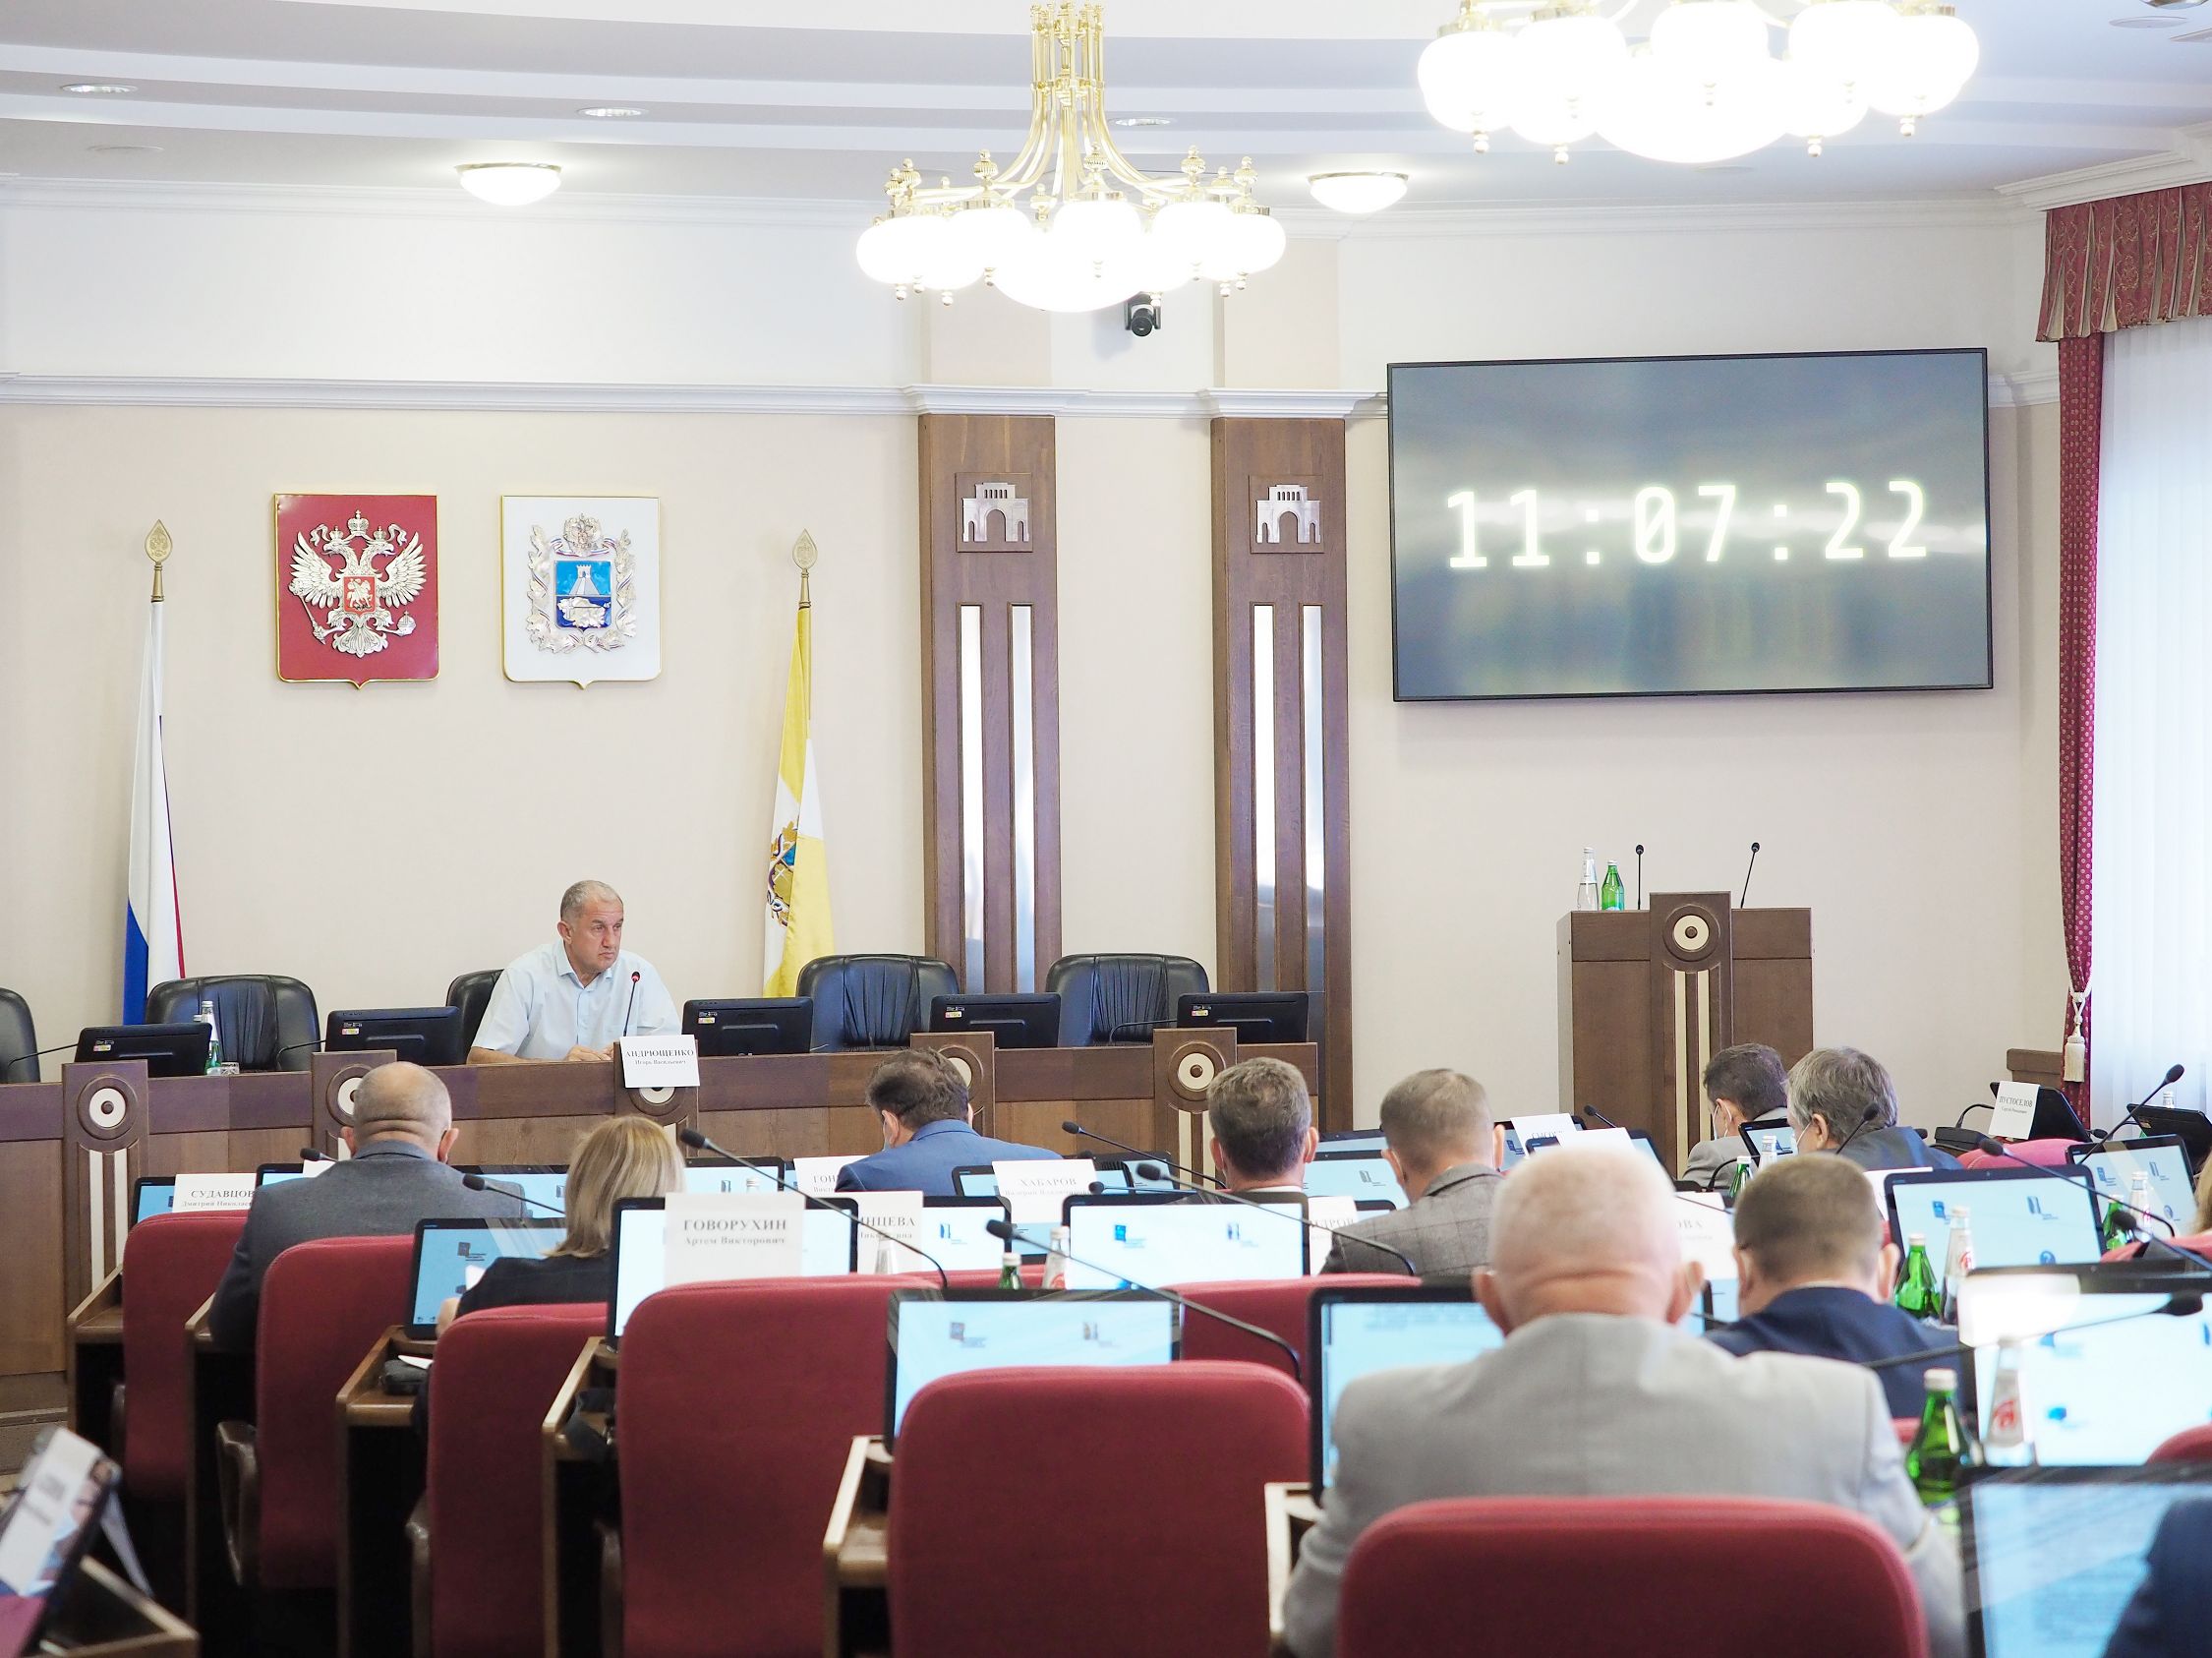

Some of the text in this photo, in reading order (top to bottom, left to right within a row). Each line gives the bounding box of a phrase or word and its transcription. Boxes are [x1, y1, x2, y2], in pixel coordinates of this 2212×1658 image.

[1446, 480, 1928, 568] 11:07:22
[626, 1049, 694, 1058] АНДРЮЩЕНКО
[1019, 1178, 1077, 1187] ХАБАРОВ
[683, 1218, 786, 1231] ГОВОРУХИН
